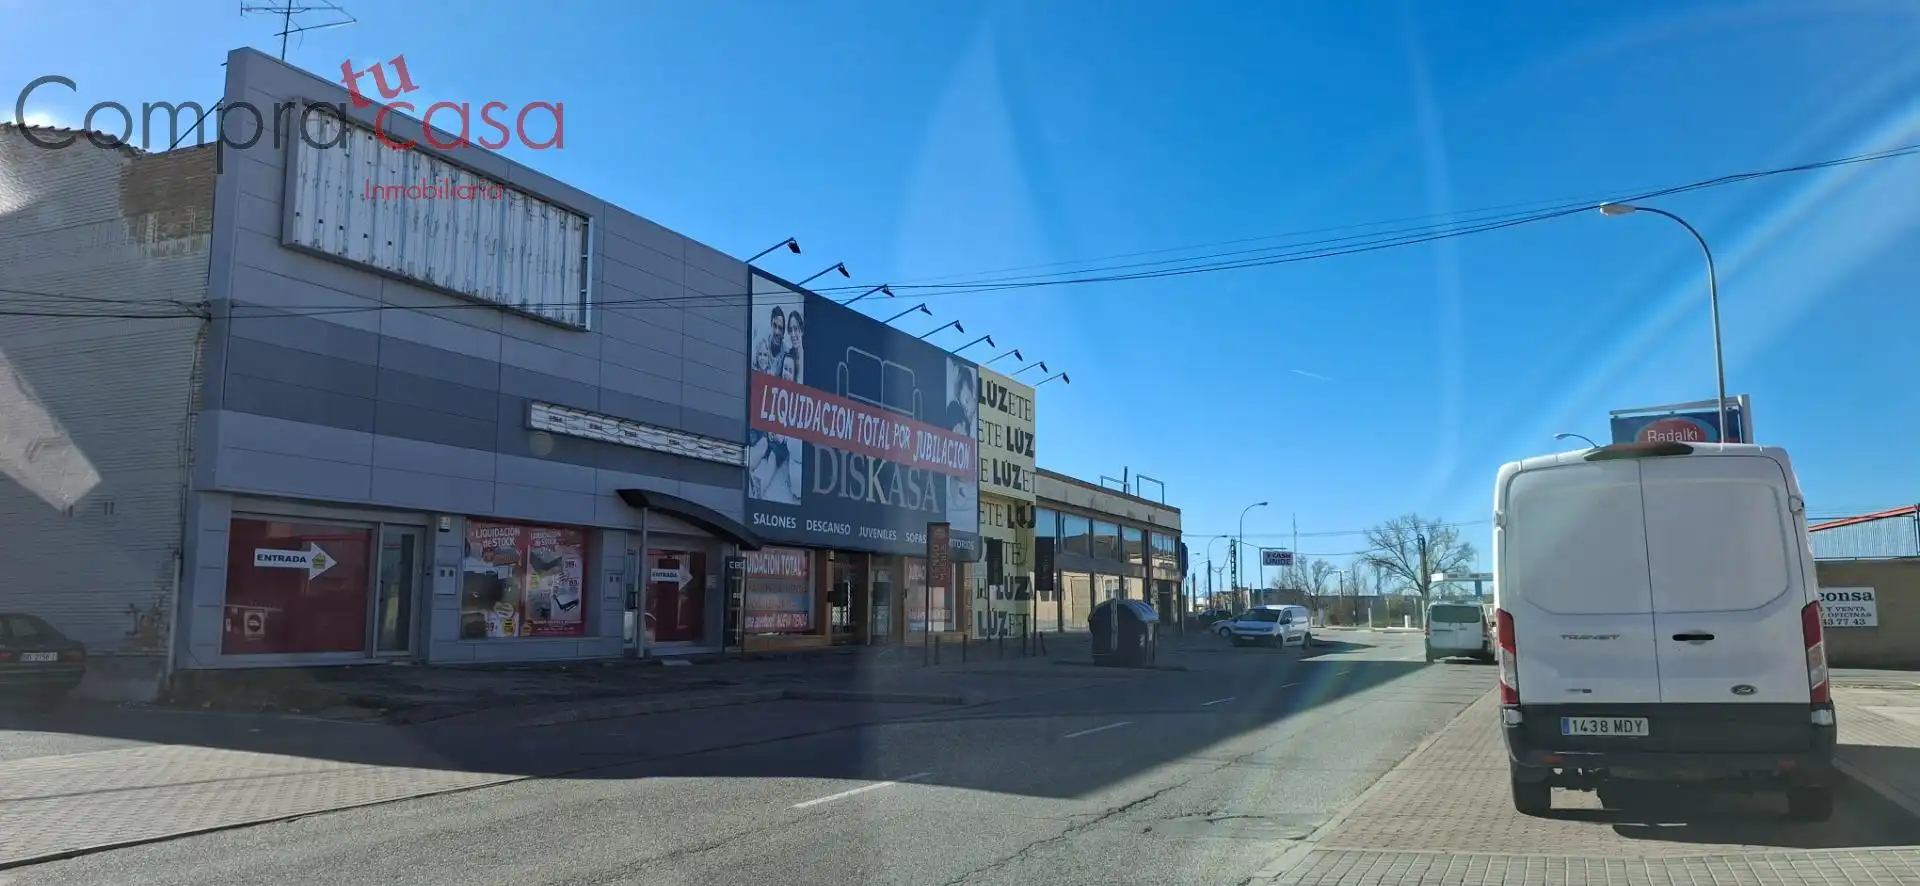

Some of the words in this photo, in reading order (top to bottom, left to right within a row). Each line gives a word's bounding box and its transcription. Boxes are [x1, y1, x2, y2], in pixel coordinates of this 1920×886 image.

[760, 384, 855, 440] LIQUIDACION
[857, 412, 890, 450] TOTAL
[893, 423, 911, 449] POR
[912, 430, 971, 469] JUBILACION
[812, 443, 941, 514] DISKASA
[753, 513, 797, 529] SALONES
[806, 519, 851, 536] DESCANSO
[859, 526, 897, 541] JUVENILES
[493, 537, 516, 548] STOCK
[256, 553, 307, 564] ENTRADA
[1572, 719, 1609, 733] 1438
[1613, 719, 1643, 733] MDY
